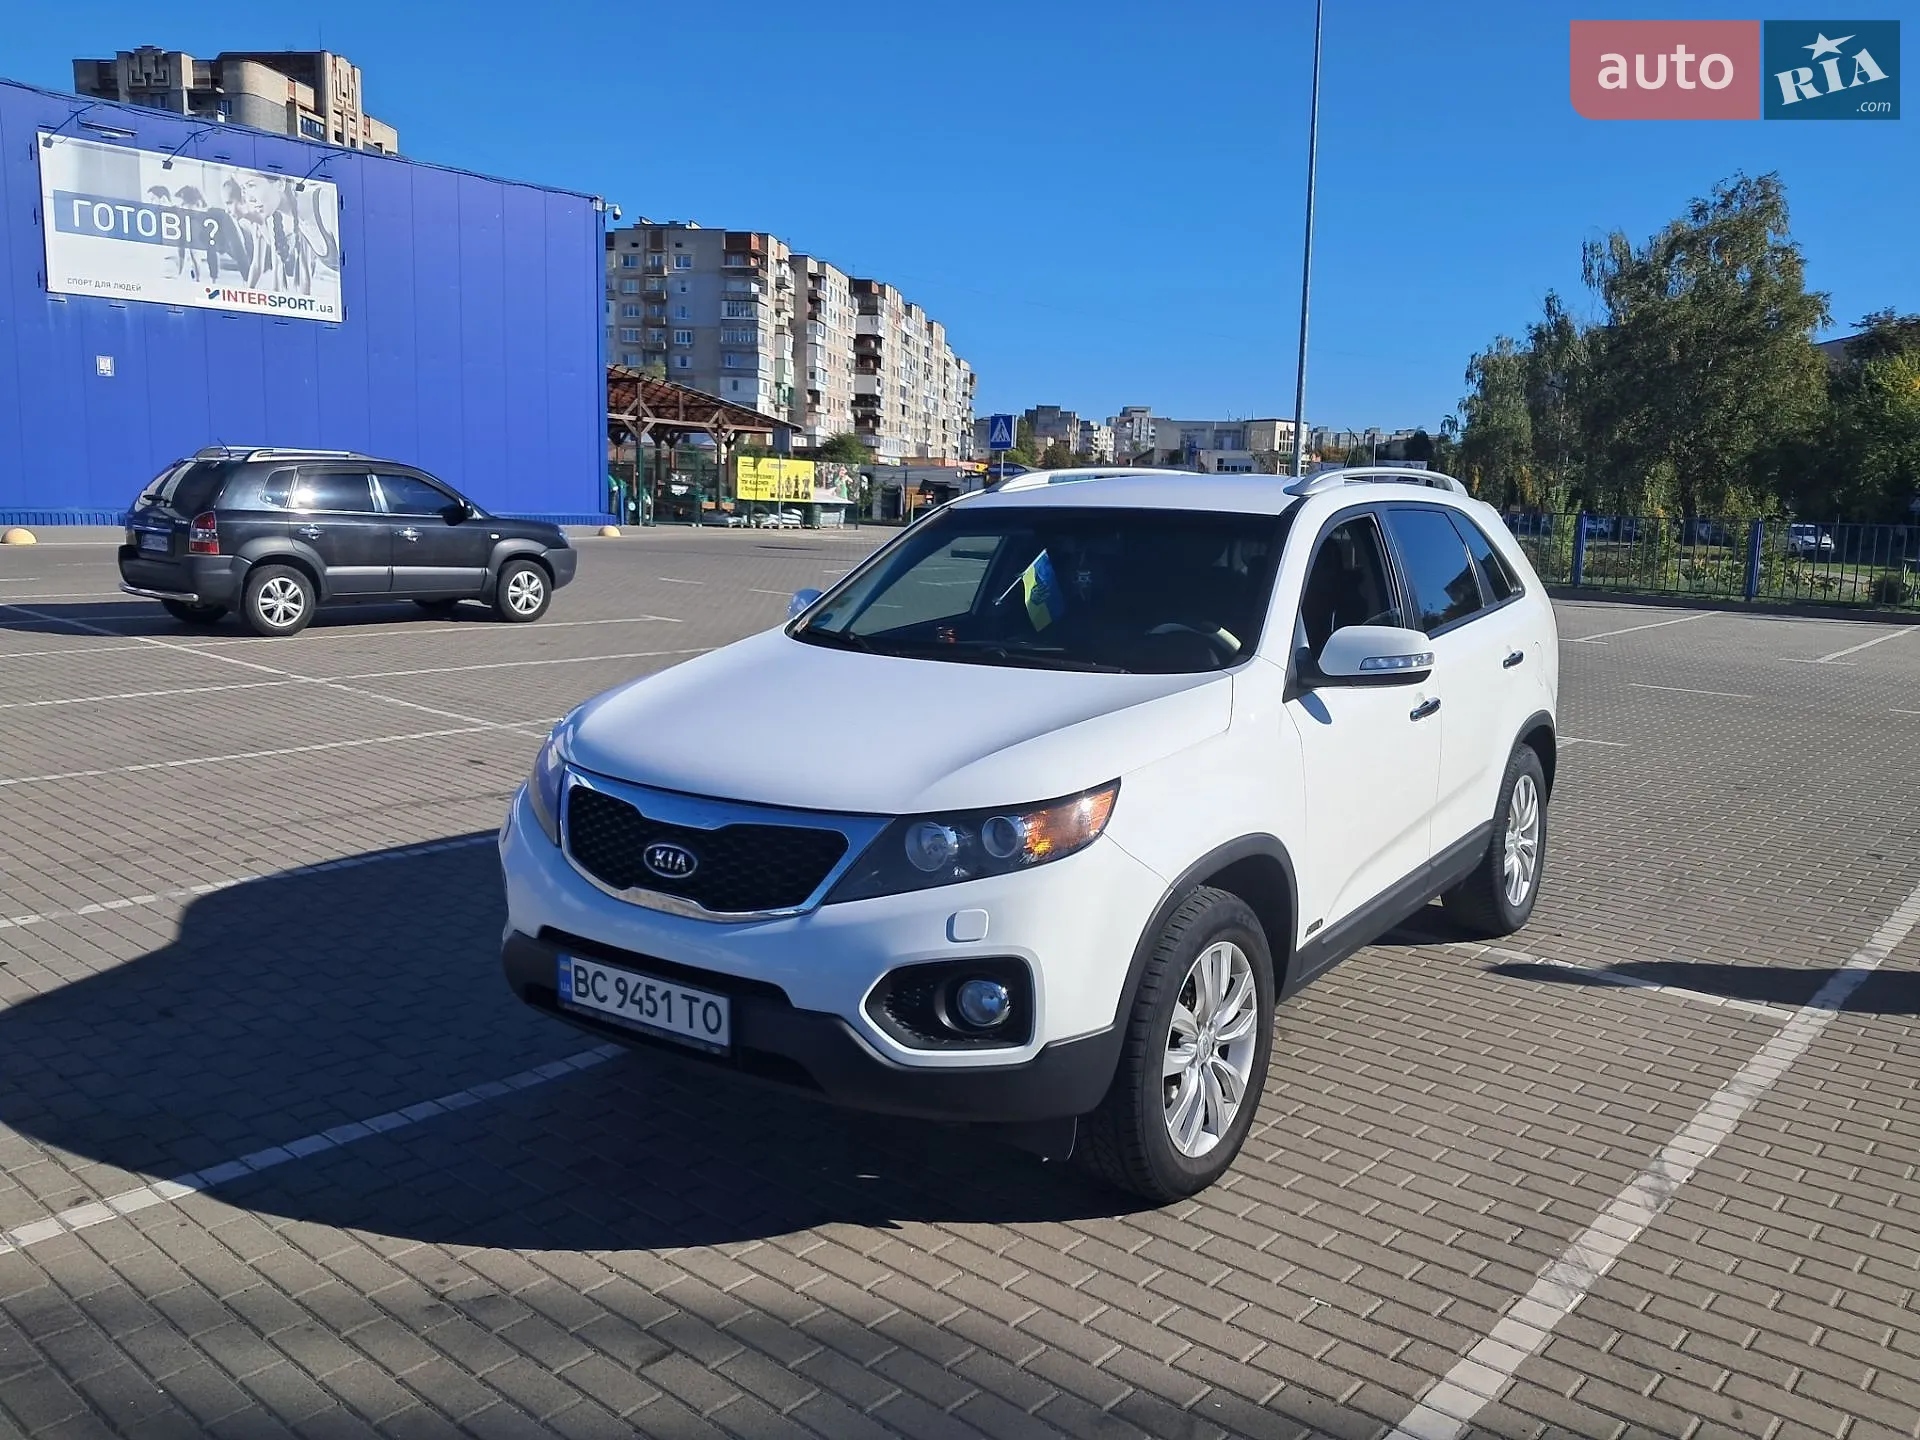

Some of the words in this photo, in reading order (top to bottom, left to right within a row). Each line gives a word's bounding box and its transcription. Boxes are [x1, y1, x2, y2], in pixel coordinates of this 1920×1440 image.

[73, 200, 191, 242] ГОТОВІ
[67, 277, 92, 286] СПОРТ
[94, 280, 112, 289] ДЛЯ
[222, 288, 334, 313] INTERSPORT.ua
[653, 848, 687, 872] KIA
[573, 964, 608, 1003] BC
[614, 977, 672, 1023] 9451
[680, 993, 722, 1035] TO
